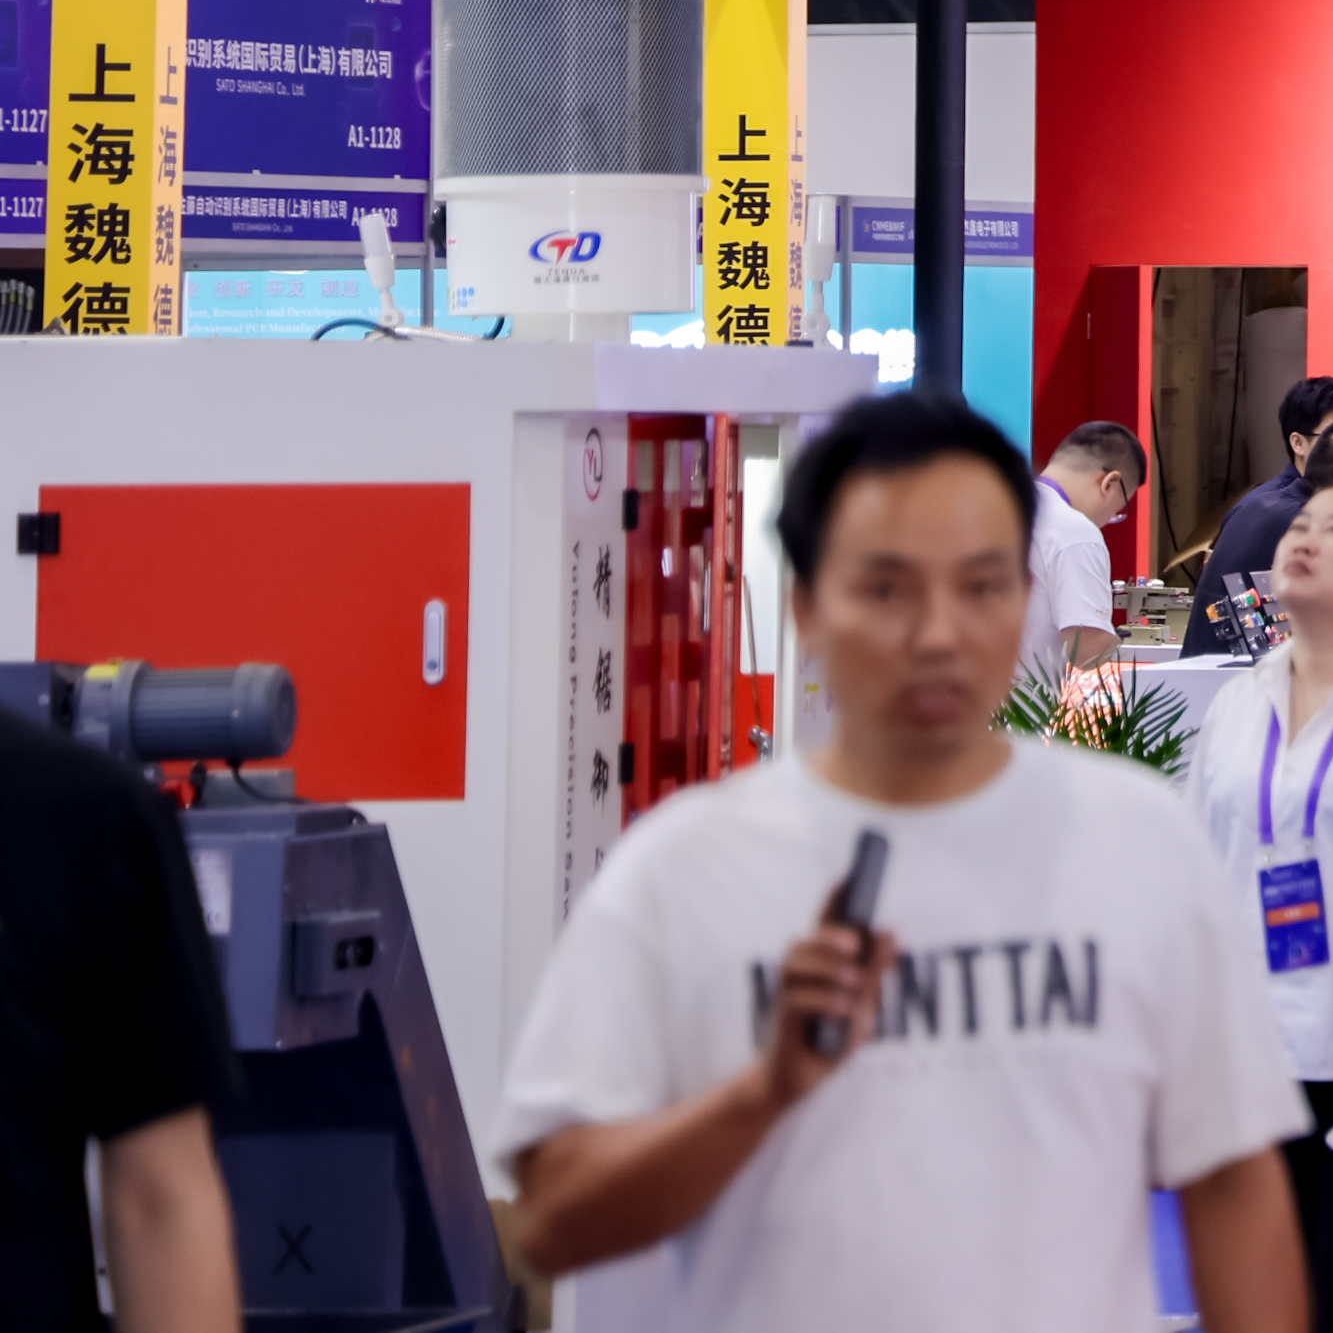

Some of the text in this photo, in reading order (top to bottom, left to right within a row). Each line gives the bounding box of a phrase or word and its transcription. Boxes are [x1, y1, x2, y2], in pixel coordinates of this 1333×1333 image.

[216, 79, 236, 93] SATO
[237, 80, 275, 95] SHANGHAI
[348, 126, 402, 150] A1-1128
[62, 43, 136, 336] 上海魏德
[153, 45, 178, 336] 上海魏德
[716, 115, 771, 346] 上海魏德
[566, 675, 577, 839] Precision
